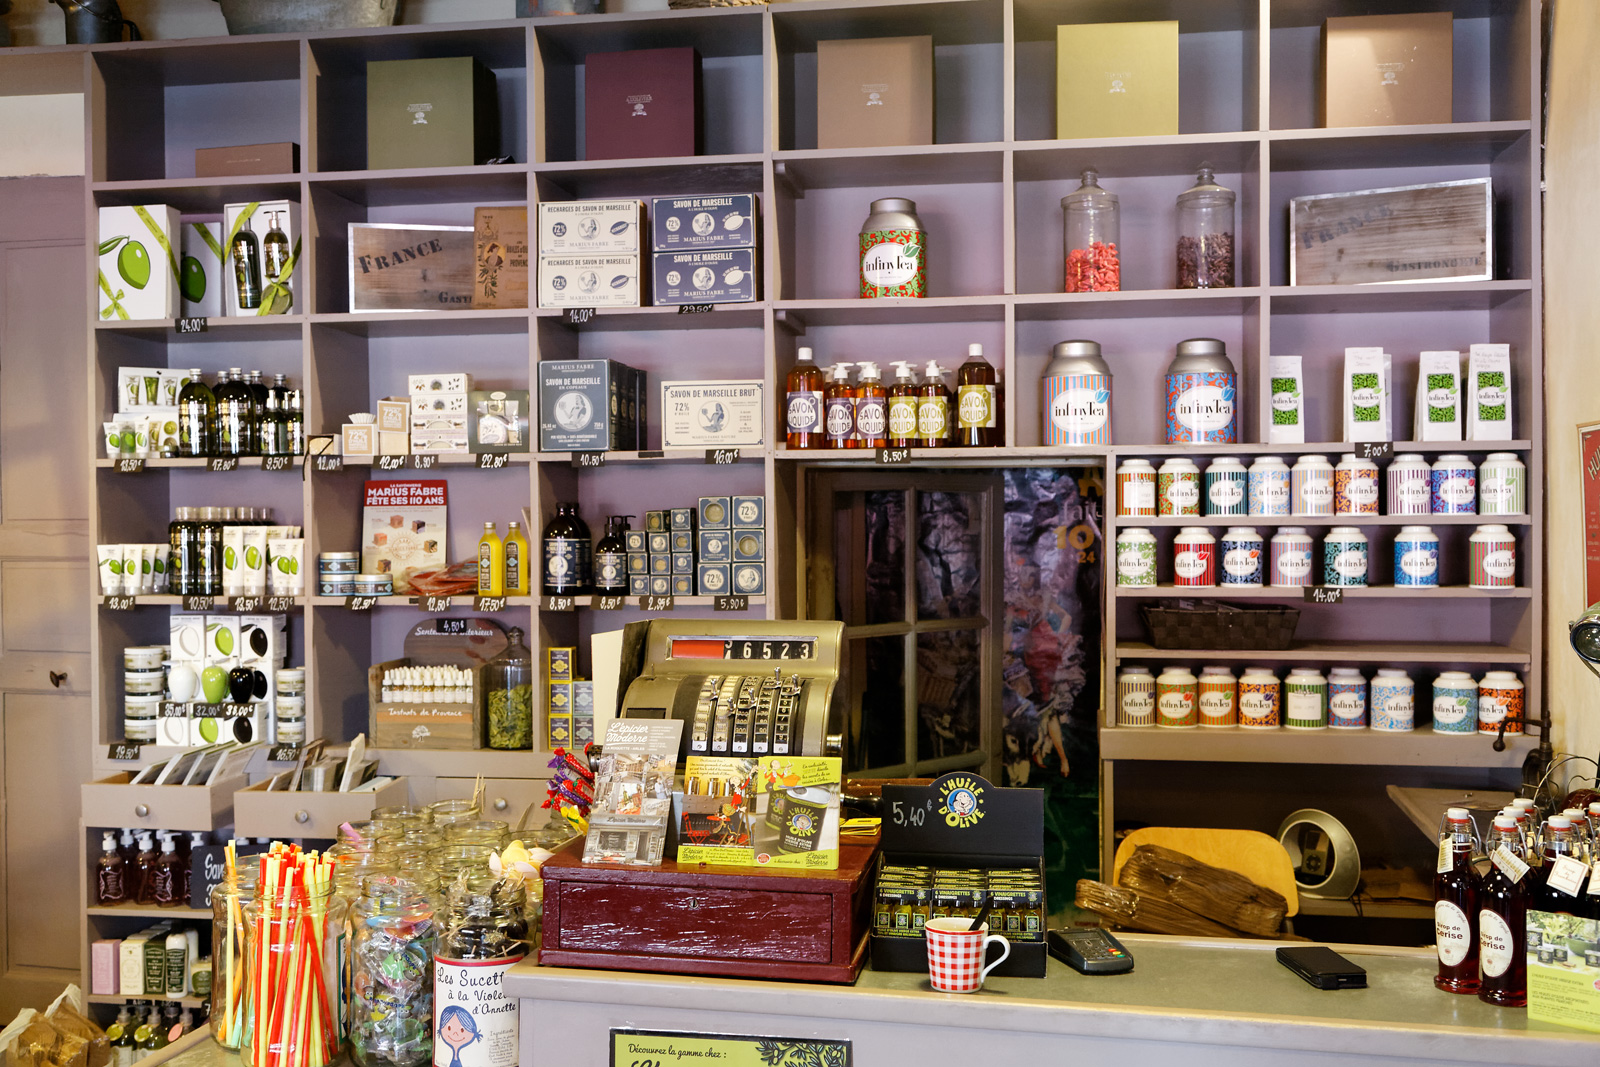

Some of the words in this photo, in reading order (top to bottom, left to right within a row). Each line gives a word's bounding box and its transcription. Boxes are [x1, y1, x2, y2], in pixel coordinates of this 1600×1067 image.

[673, 200, 691, 208] SAVON
[702, 198, 732, 206] MARSEILLE
[1301, 205, 1393, 249] FRANCE
[358, 238, 443, 274] FRANCE
[674, 255, 692, 263] SAVON
[702, 252, 733, 261] MARSEILLE
[570, 309, 594, 324] 14,00€
[703, 389, 737, 397] MARSEILLE
[675, 403, 689, 411] 72%
[788, 402, 813, 414] SAVON
[961, 397, 985, 408] SAVON
[829, 408, 849, 421] SAVON
[860, 408, 885, 420] SAVON
[789, 416, 814, 426] LIQUIDE
[860, 422, 885, 433] LIQUIDE
[368, 488, 408, 496] MARIUS
[367, 496, 389, 505] FÊTE
[741, 506, 755, 515] 72%
[707, 574, 721, 583] 72%
[1313, 589, 1340, 603] 14,00€
[721, 599, 744, 610] 5,90€
[389, 708, 417, 716] Instants
[422, 708, 429, 716] de
[432, 708, 462, 717] Provence
[608, 722, 649, 735] L'épicier
[606, 733, 647, 742] Moderne
[939, 777, 984, 796] L'HUILE
[789, 807, 818, 820] L'HUILE
[938, 807, 985, 828] D'OLIVE
[786, 822, 817, 837] D'OLIVE
[437, 967, 454, 984] Les
[448, 990, 454, 1000] à
[458, 990, 469, 1001] la
[472, 1003, 516, 1015] d'Annette
[628, 1043, 666, 1055] Découvrez
[668, 1045, 676, 1056] la
[677, 1048, 703, 1060] gamme
[705, 1048, 720, 1057] chez
